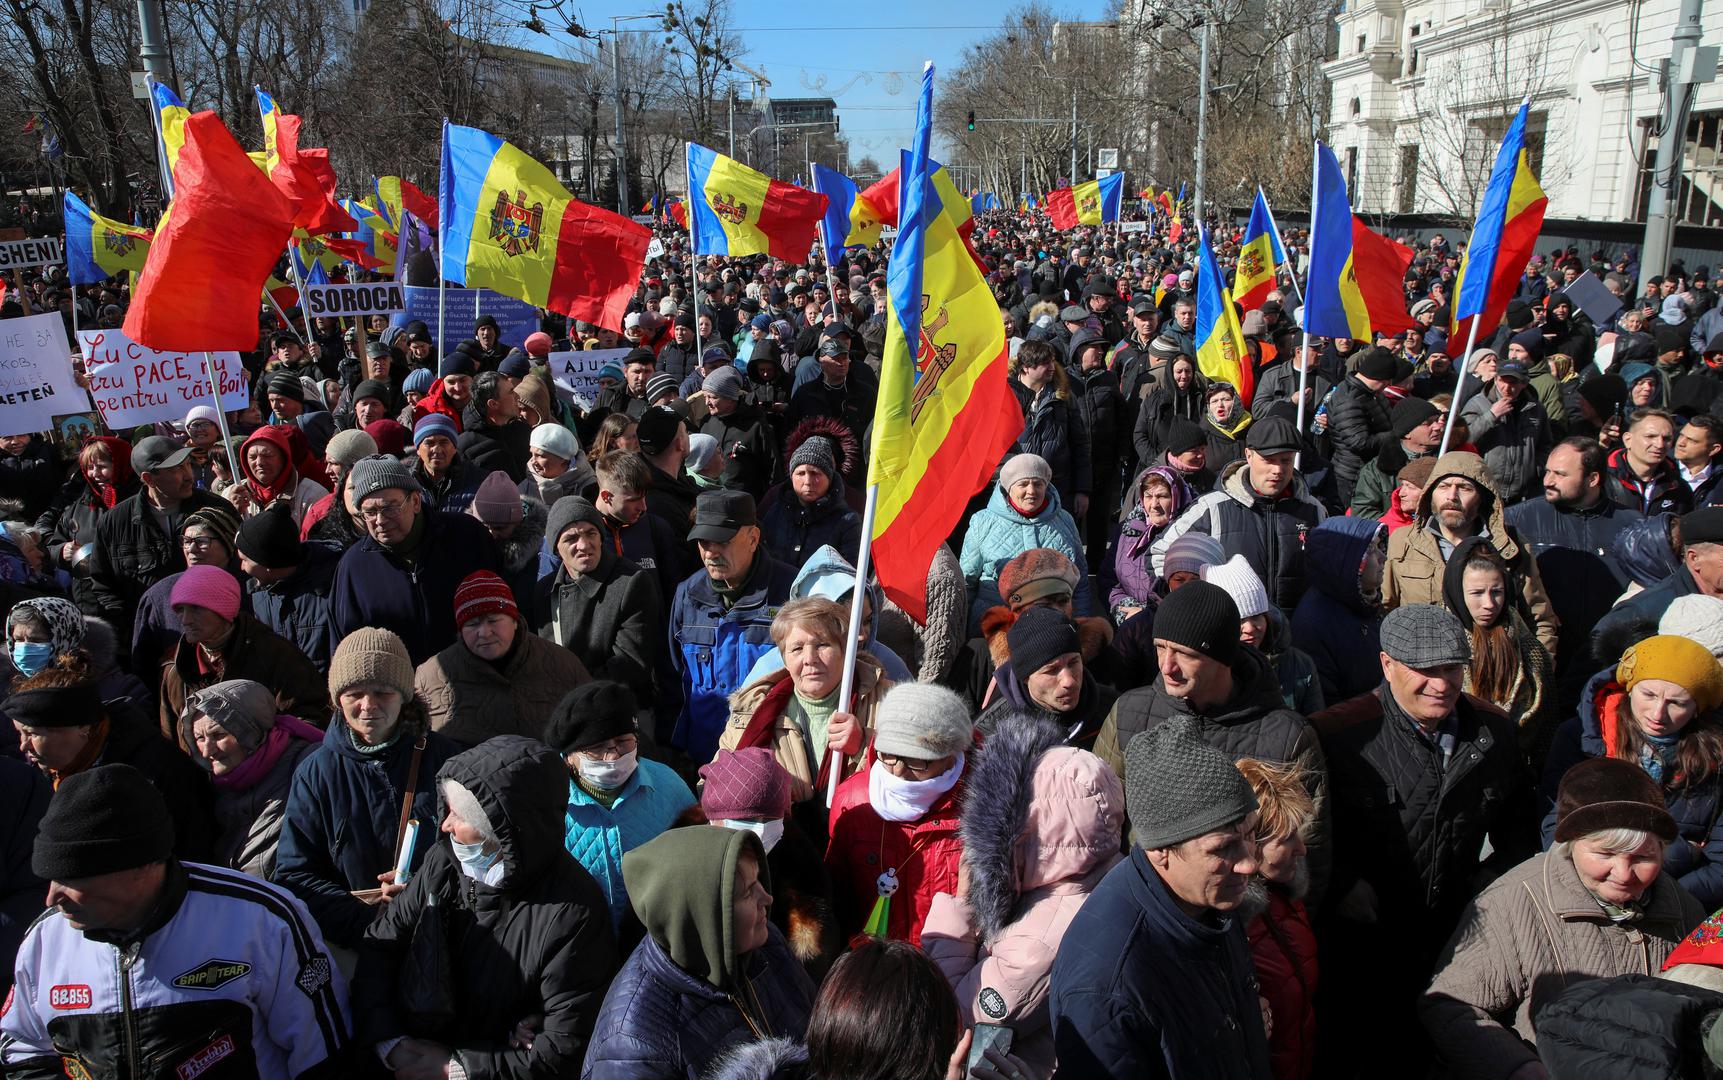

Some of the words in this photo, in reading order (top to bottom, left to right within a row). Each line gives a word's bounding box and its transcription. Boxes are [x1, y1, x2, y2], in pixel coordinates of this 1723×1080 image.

[309, 287, 404, 314] SOROCA
[134, 357, 192, 388] PACE,
[97, 388, 168, 421] pentru
[179, 971, 207, 986] GRIP
[217, 964, 245, 979] TEAR
